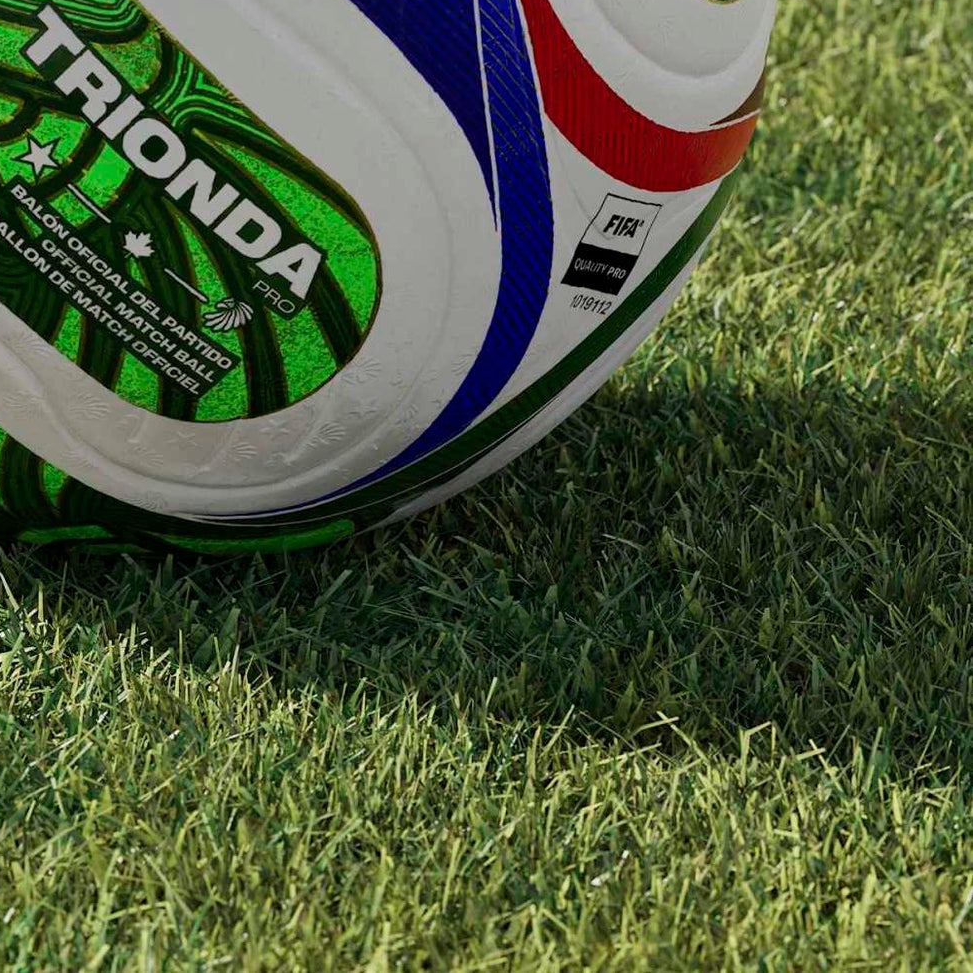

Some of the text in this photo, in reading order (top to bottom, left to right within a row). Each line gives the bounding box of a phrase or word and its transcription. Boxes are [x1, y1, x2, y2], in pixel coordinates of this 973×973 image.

[26, 4, 323, 300] TRIONDA
[10, 184, 232, 370] BALÓN OFICIAL DEL PARTIDO
[42, 239, 215, 383] OFFICIAL MATCH BALL
[252, 280, 296, 314] PRO
[570, 294, 612, 314] 1019112
[574, 258, 626, 279] QUALITY PRO
[48, 270, 76, 294] DE
[72, 290, 134, 342] MATCH
[132, 340, 200, 395] OFFICIEL
